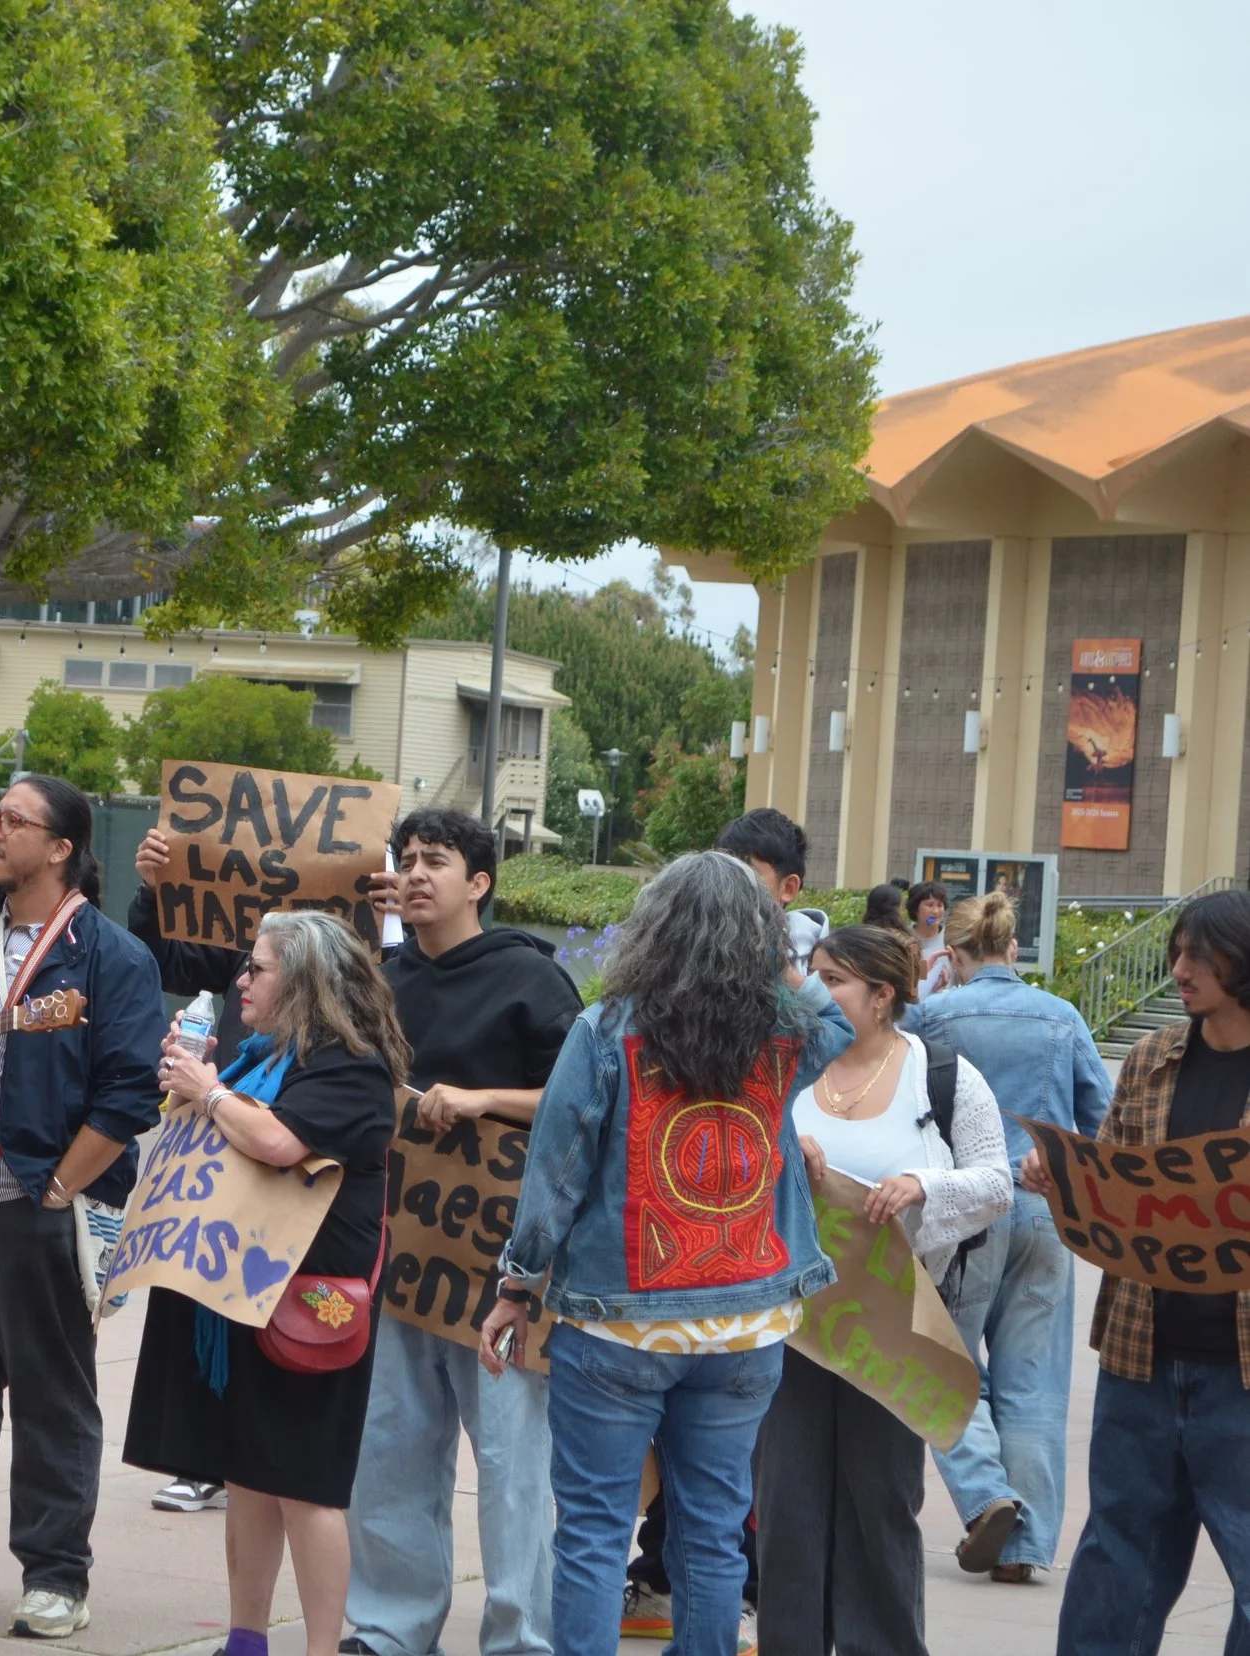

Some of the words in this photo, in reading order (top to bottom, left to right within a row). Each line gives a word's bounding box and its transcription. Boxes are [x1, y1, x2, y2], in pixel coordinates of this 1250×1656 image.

[169, 765, 373, 856] SAVE
[187, 844, 300, 896] LAS
[399, 1097, 531, 1181] LAS
[141, 1161, 224, 1212] LAS
[106, 1215, 240, 1283] ESTRAS
[1090, 1222, 1250, 1284] open
